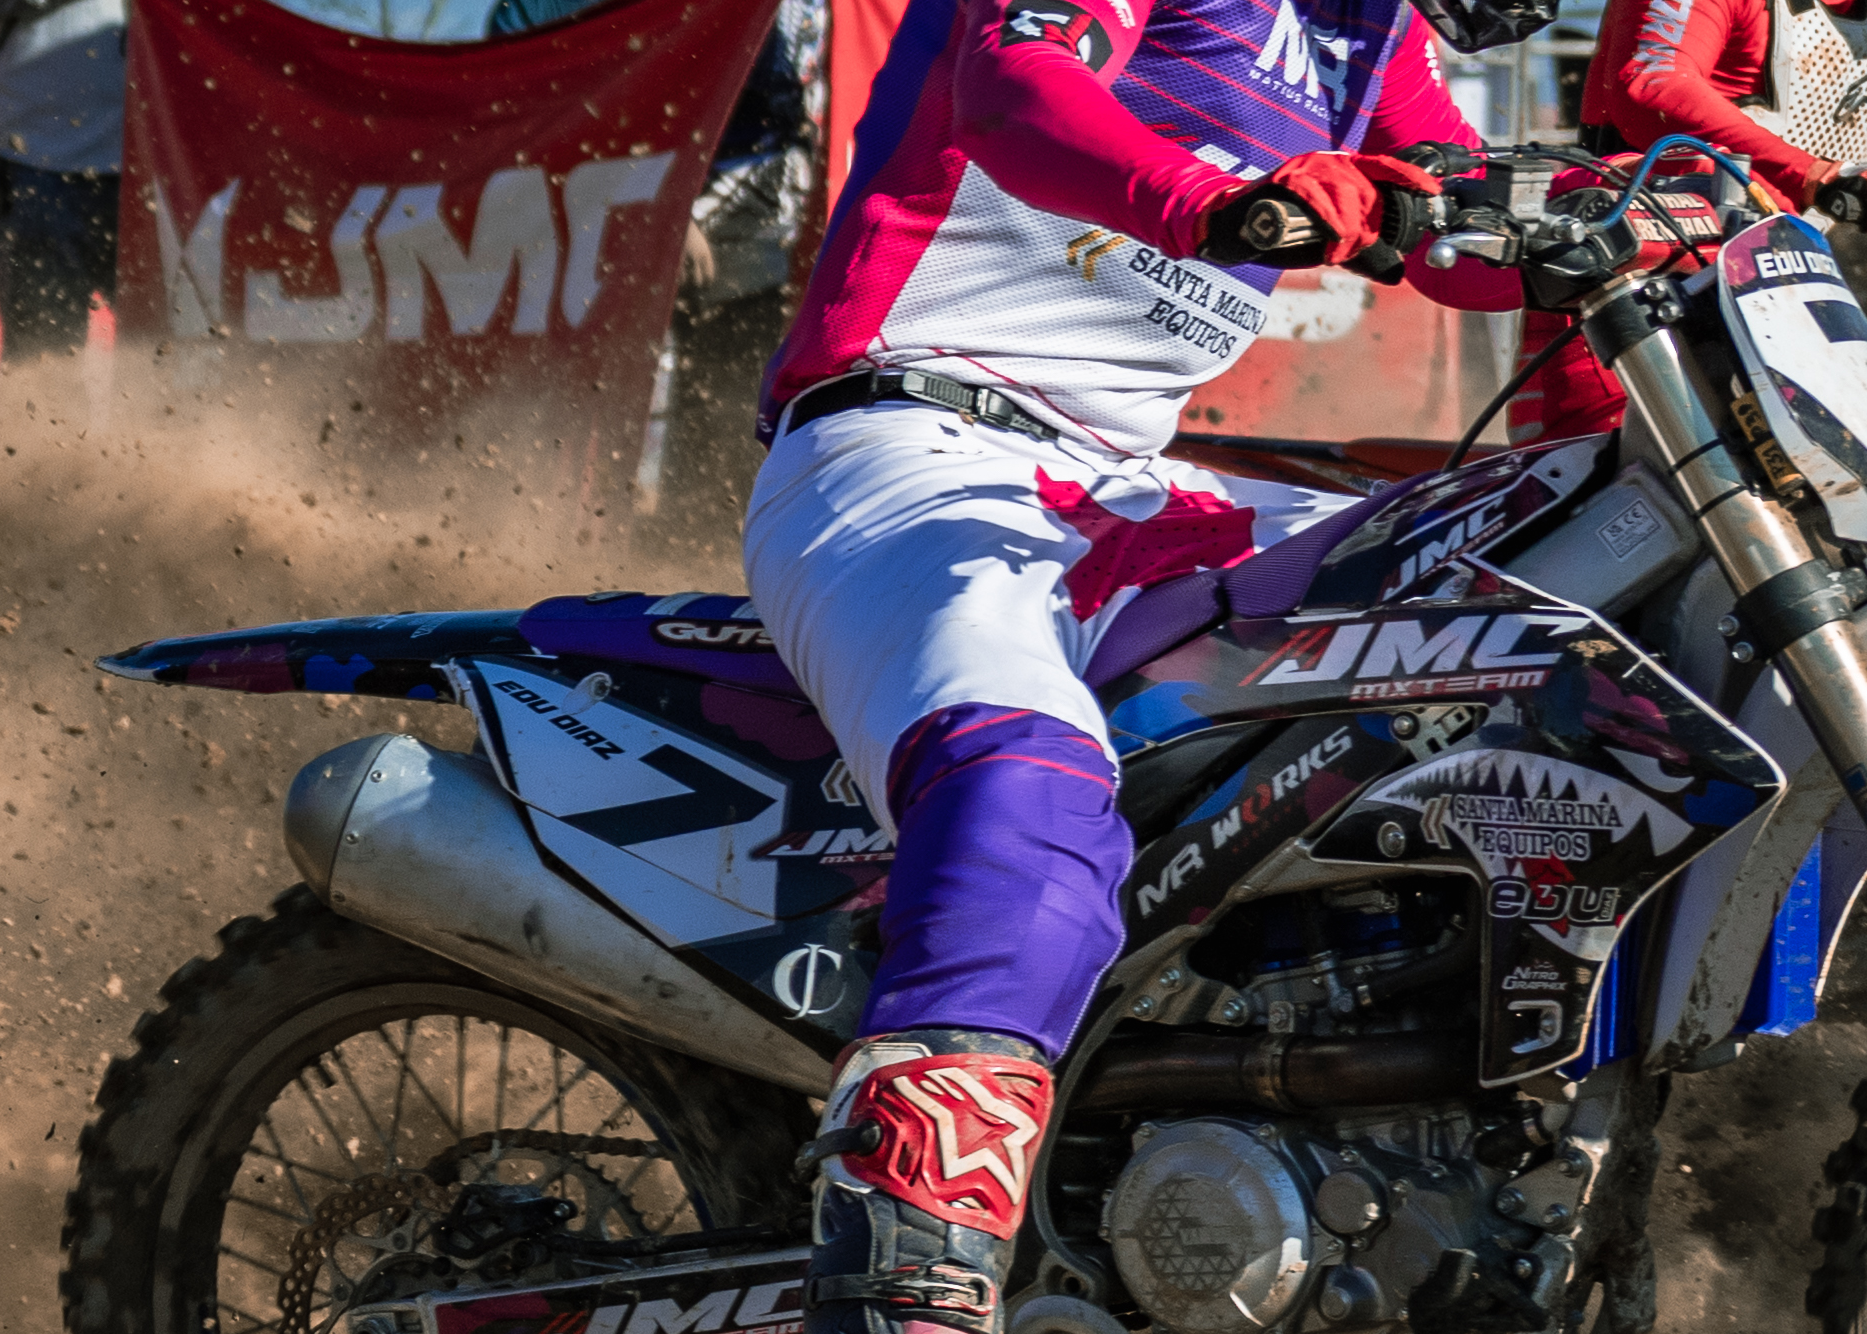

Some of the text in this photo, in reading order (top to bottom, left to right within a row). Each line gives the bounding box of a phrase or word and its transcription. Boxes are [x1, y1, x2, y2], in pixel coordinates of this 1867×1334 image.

[1129, 246, 1211, 310] SANTA
[1753, 251, 1804, 279] EDU
[1142, 298, 1238, 360] EQUIPOS
[1254, 615, 1590, 687] JMC
[1349, 668, 1554, 701] MXTEAM
[491, 679, 626, 762] EDU DIAZ
[556, 742, 780, 848] 7
[1454, 795, 1623, 828] SANTA MARINA
[1480, 827, 1591, 861] EQUIPOS
